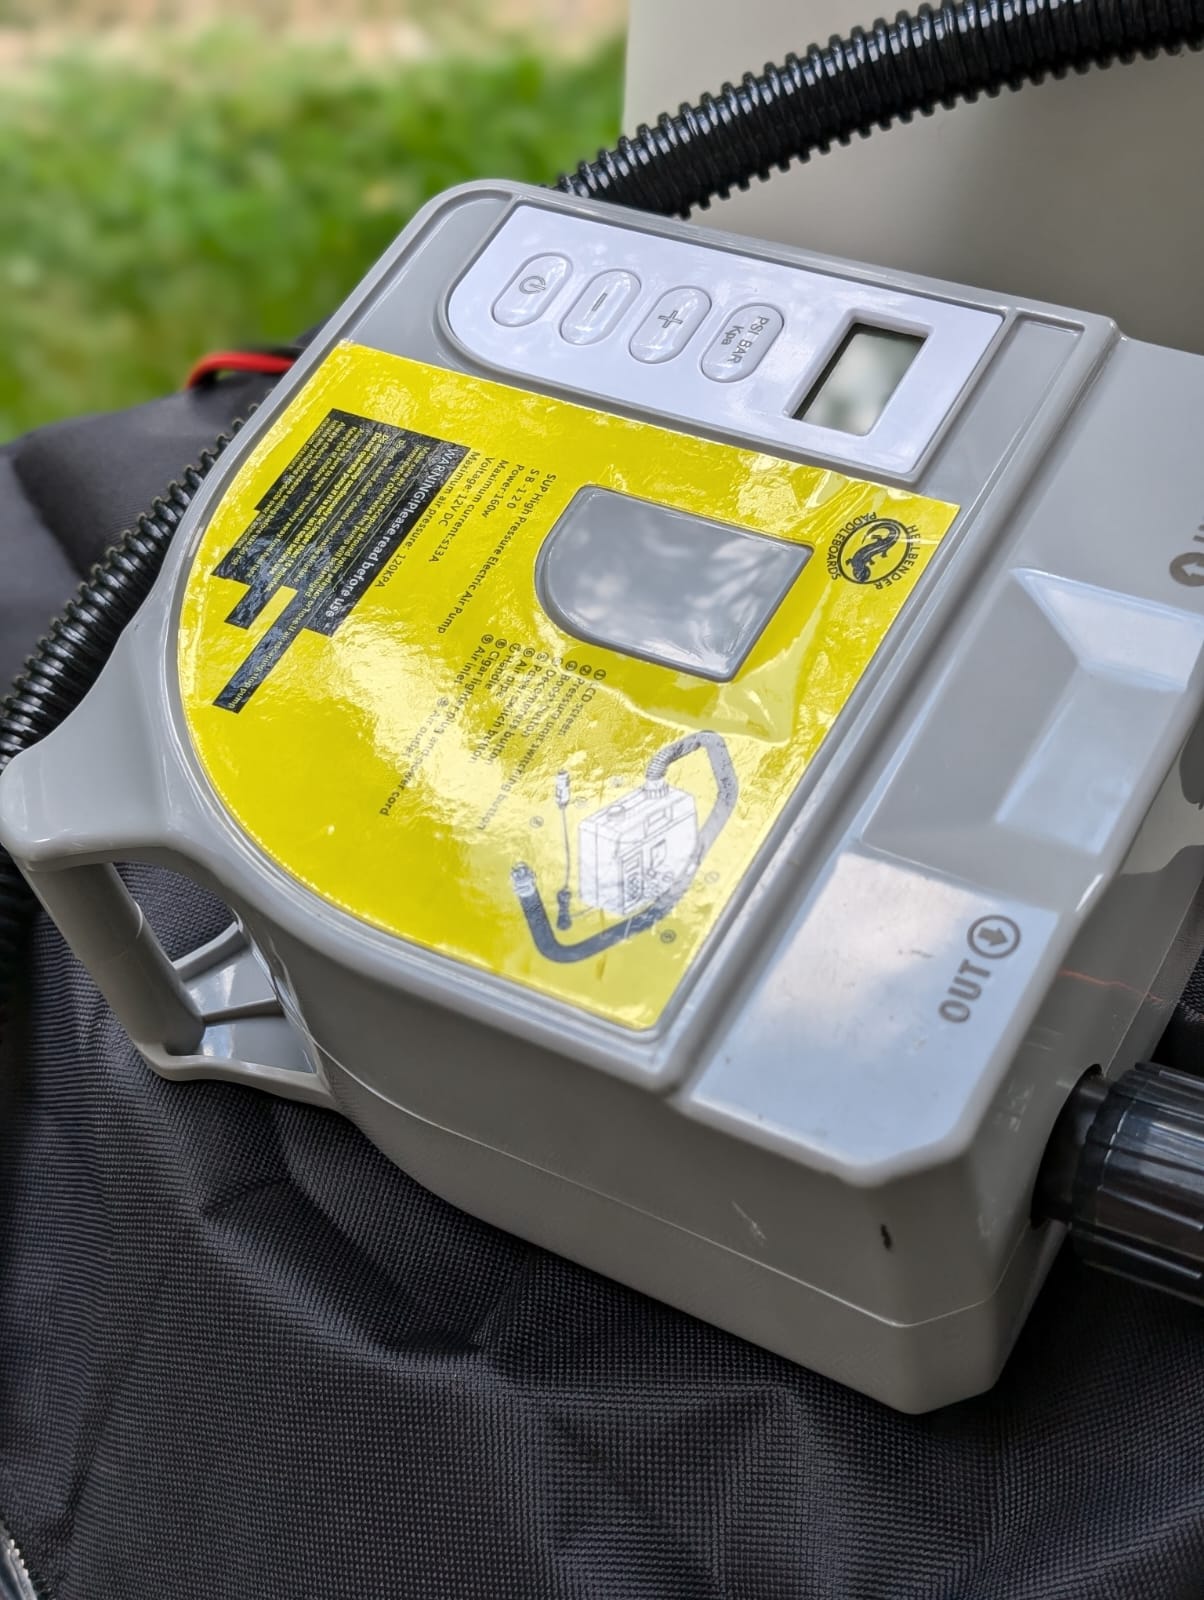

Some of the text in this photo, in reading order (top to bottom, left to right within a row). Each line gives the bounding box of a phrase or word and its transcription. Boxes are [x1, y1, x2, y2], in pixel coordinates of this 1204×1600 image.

[721, 325, 744, 345] Kpa
[727, 316, 770, 363] PSI BAR
[334, 472, 351, 489] pump
[351, 463, 367, 479] pump
[444, 451, 479, 494] Maximum
[473, 460, 508, 503] Maximum
[435, 495, 448, 507] air
[439, 456, 493, 526] Voltage: 12V DC
[343, 526, 361, 544] pump
[345, 533, 366, 556] around
[368, 536, 392, 560] read
[827, 512, 877, 581] PADDLEBOARDS
[437, 473, 556, 634] SUP High Pressure Electric Air Pump
[341, 561, 373, 597] before
[376, 553, 405, 588] 120KPA
[325, 598, 342, 617] use
[472, 646, 486, 660] Air
[475, 649, 500, 676] Cigar
[513, 660, 527, 673] Air
[455, 662, 475, 684] inlet
[485, 655, 514, 689] Handle
[535, 722, 553, 743] unit
[558, 703, 585, 736] screen
[468, 729, 497, 764] button
[485, 731, 514, 765] button
[500, 743, 542, 792] switching
[380, 791, 403, 816] cord
[477, 794, 508, 830] button
[938, 958, 991, 1024] OUT
